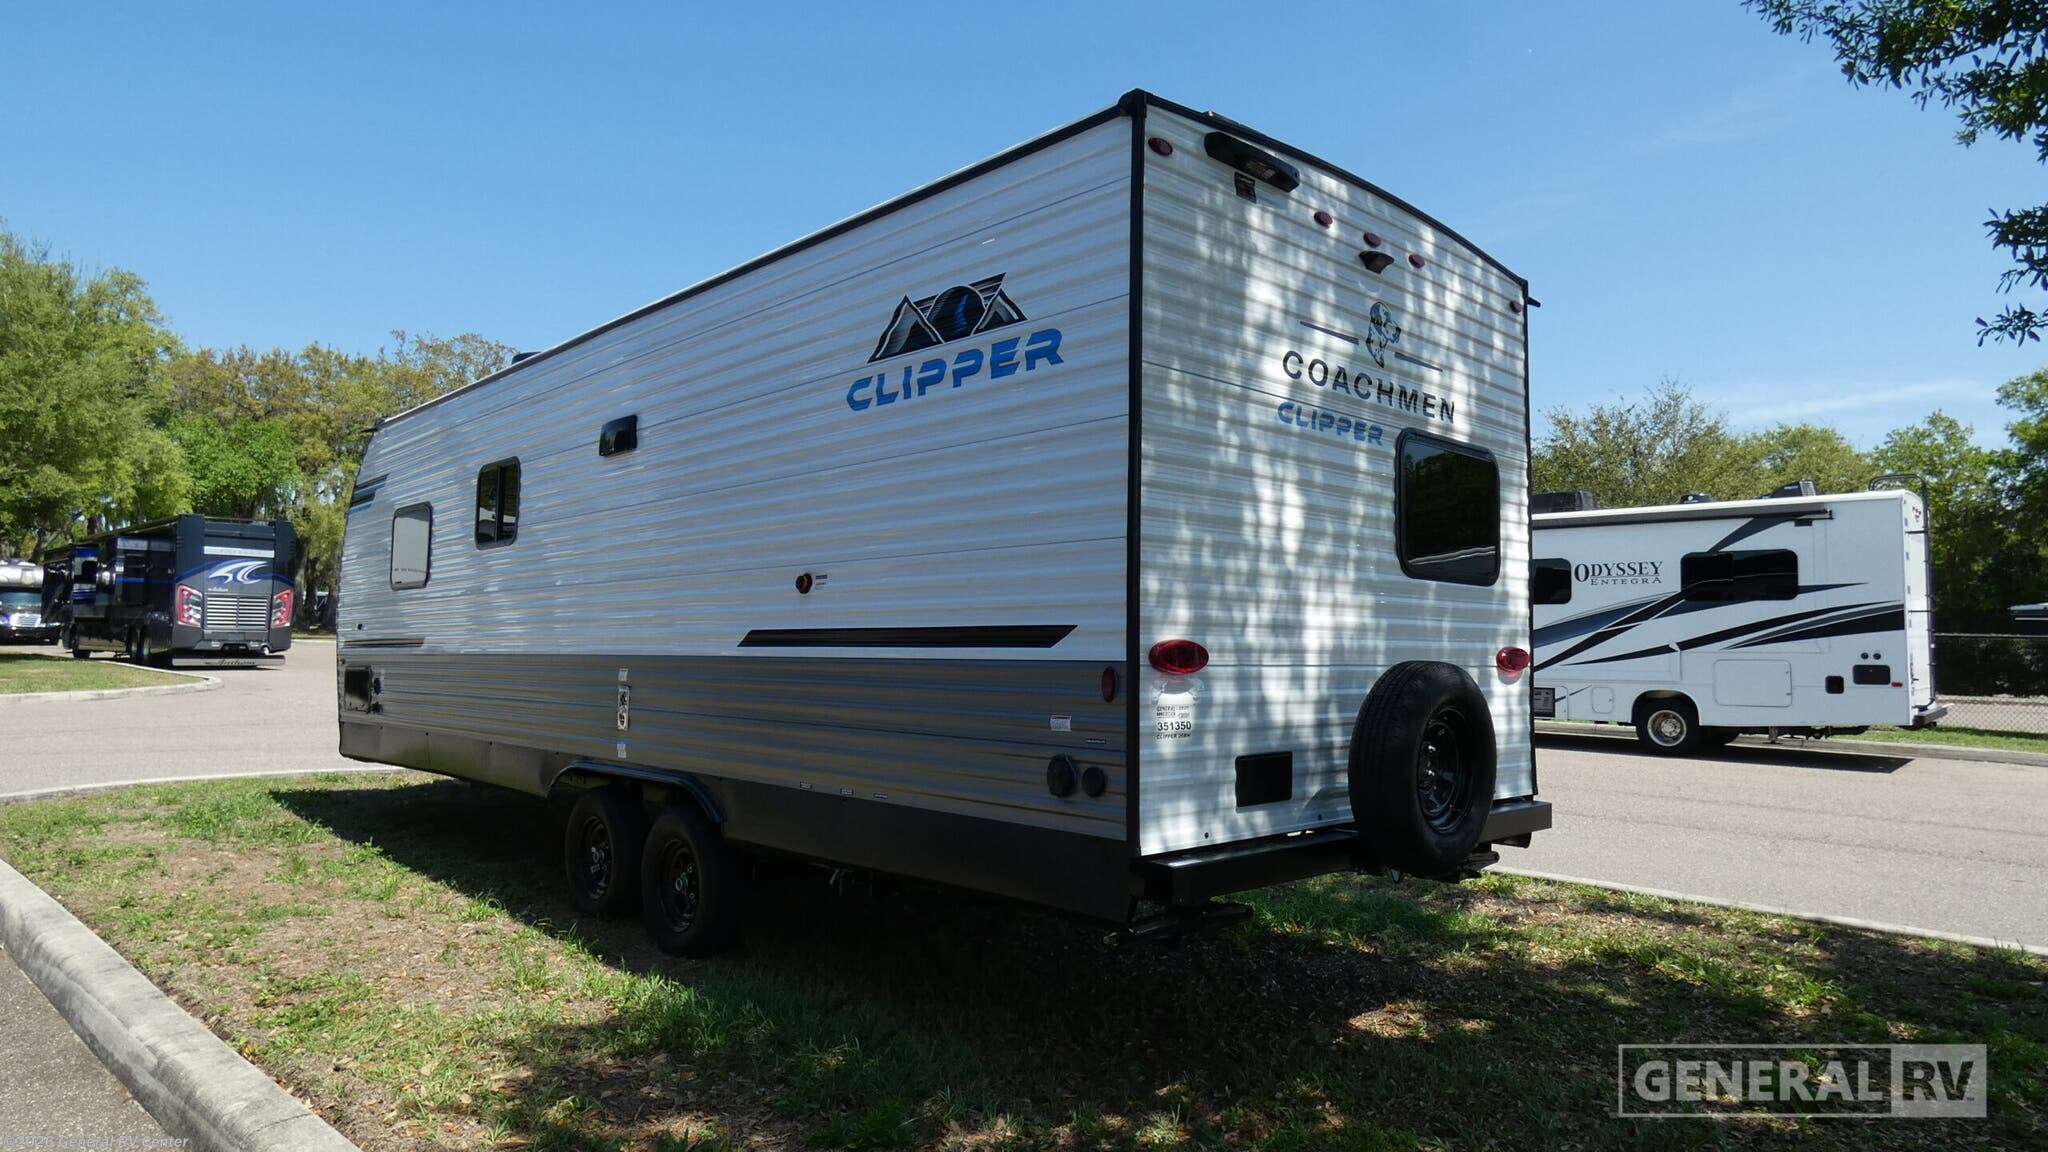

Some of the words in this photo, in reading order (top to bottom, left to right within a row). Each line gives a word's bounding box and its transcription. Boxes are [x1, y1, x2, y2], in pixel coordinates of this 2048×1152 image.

[846, 328, 1064, 412] CLIPPER
[1282, 350, 1455, 424] COACHMEN
[1277, 401, 1383, 446] CLIPPER
[1574, 561, 1663, 582] ODYSSEY
[1590, 576, 1662, 586] ENTEGRA
[1157, 721, 1192, 731] 351350
